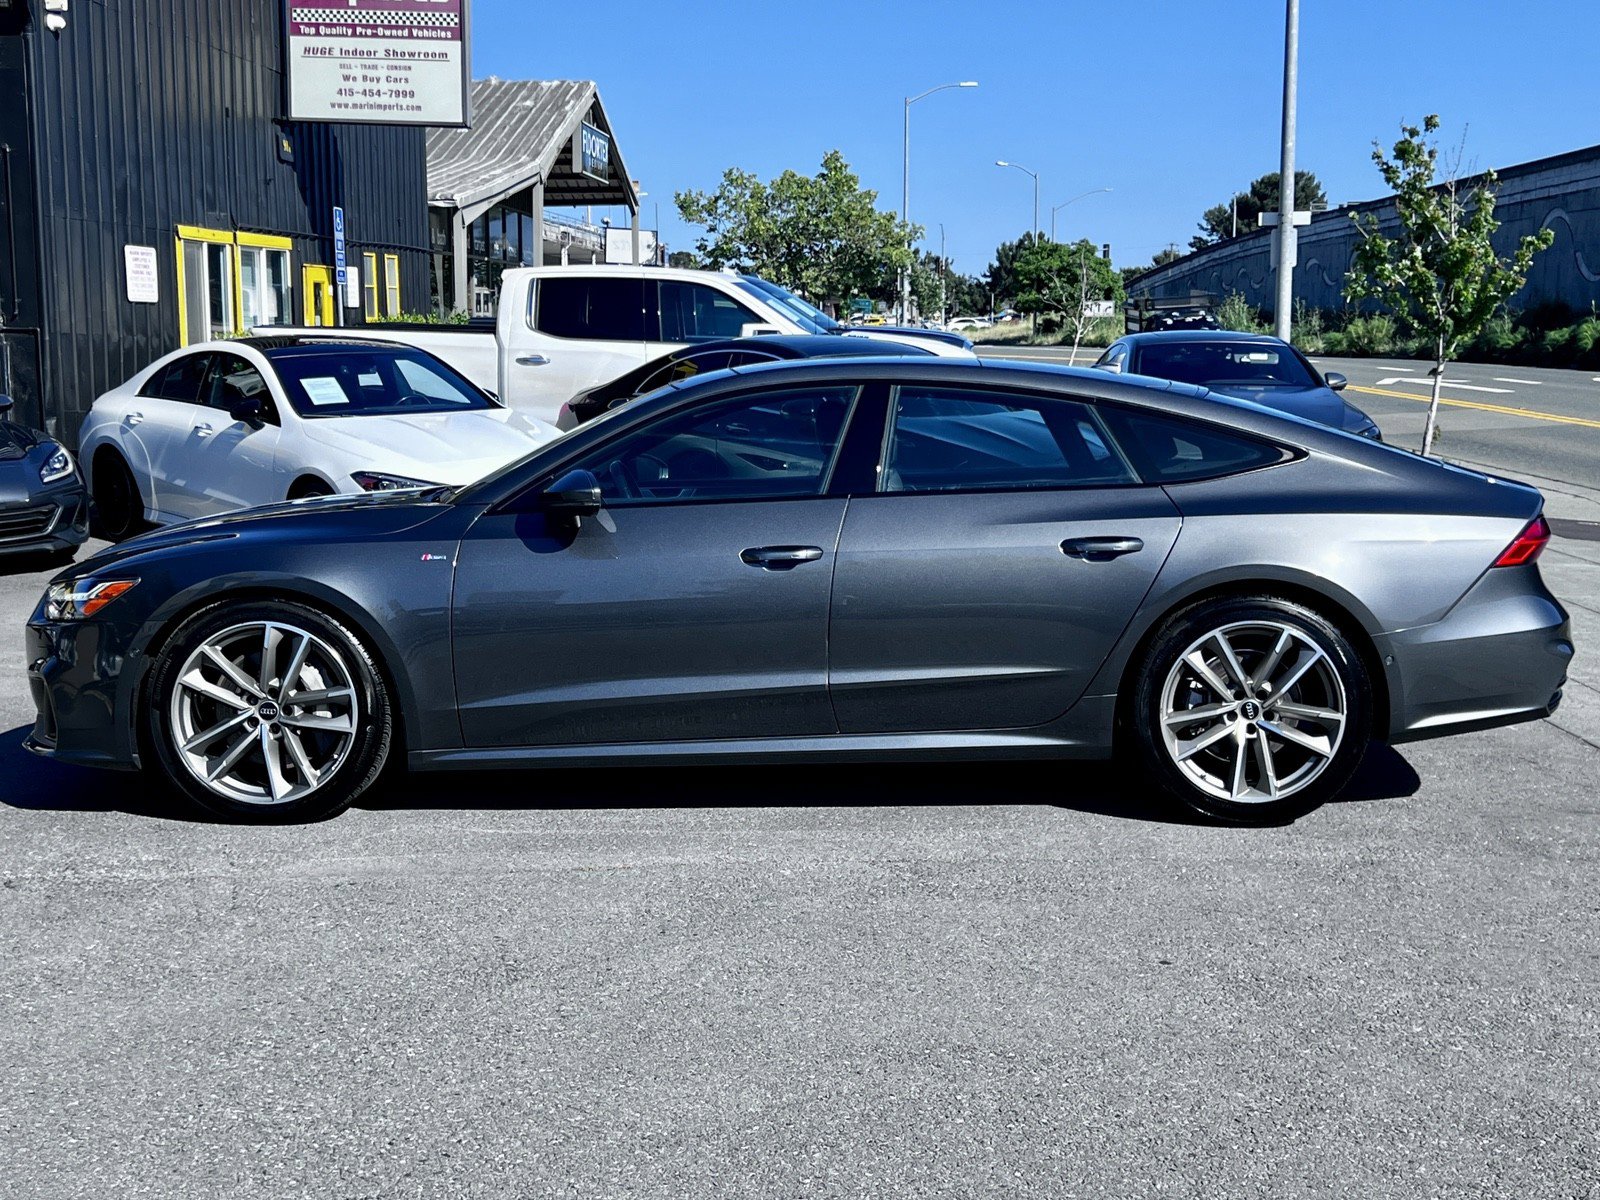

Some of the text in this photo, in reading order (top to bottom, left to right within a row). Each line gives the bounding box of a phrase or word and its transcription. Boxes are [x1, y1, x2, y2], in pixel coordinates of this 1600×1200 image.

[299, 25, 452, 38] Top Quality Pre-Owned Vehicles
[303, 46, 448, 59] HUGE Indoor Showroom
[342, 74, 409, 84] We Buy Cars
[336, 88, 415, 99] 415-454-7999
[330, 101, 422, 112] www.marinimports.com
